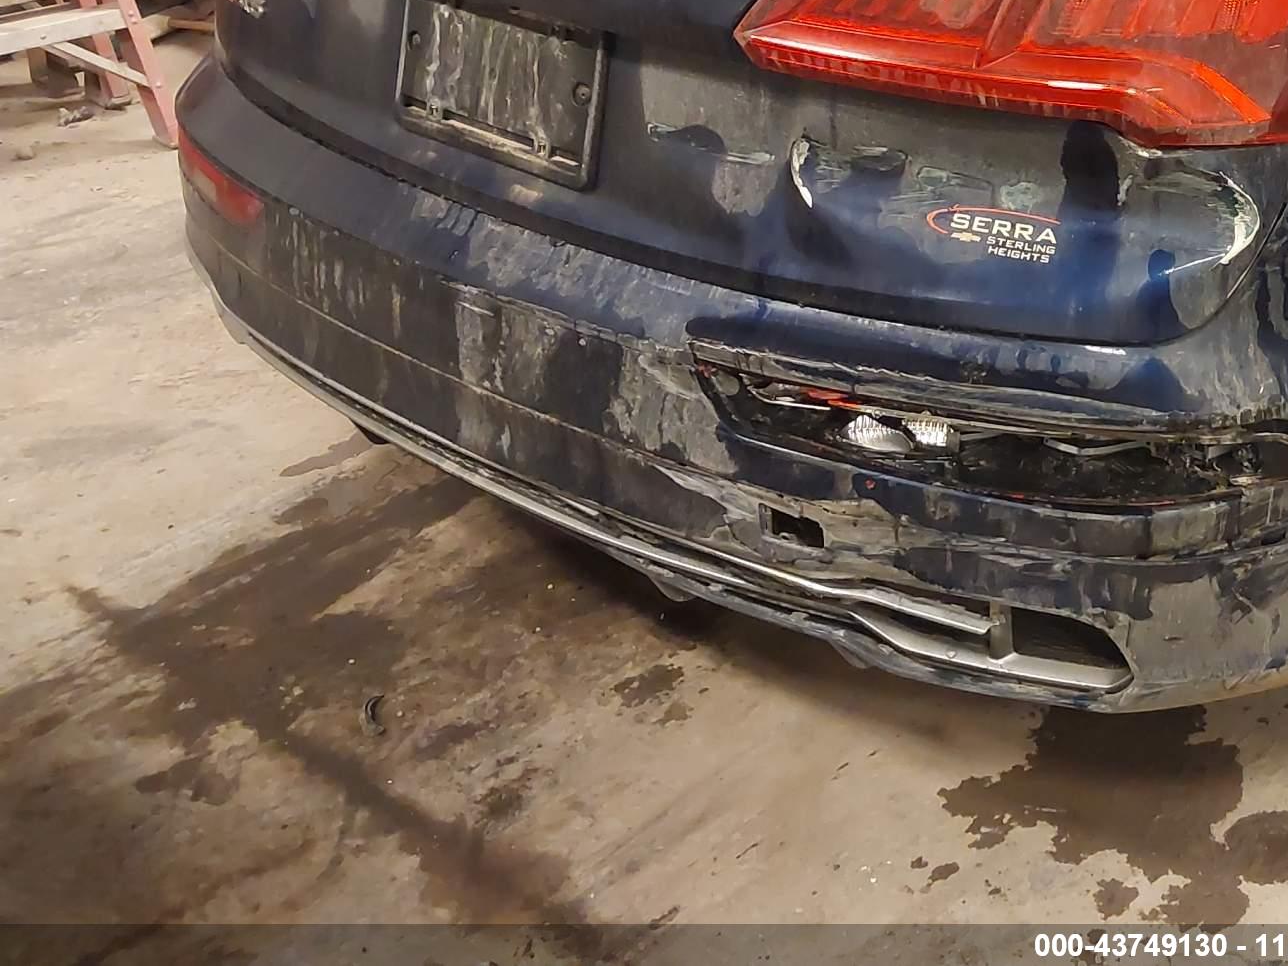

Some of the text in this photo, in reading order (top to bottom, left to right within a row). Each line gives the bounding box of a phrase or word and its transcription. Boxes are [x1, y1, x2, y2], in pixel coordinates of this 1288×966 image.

[950, 213, 1057, 244] SERRA
[986, 236, 1056, 255] STERLING
[987, 246, 1050, 264] HEIGHTS
